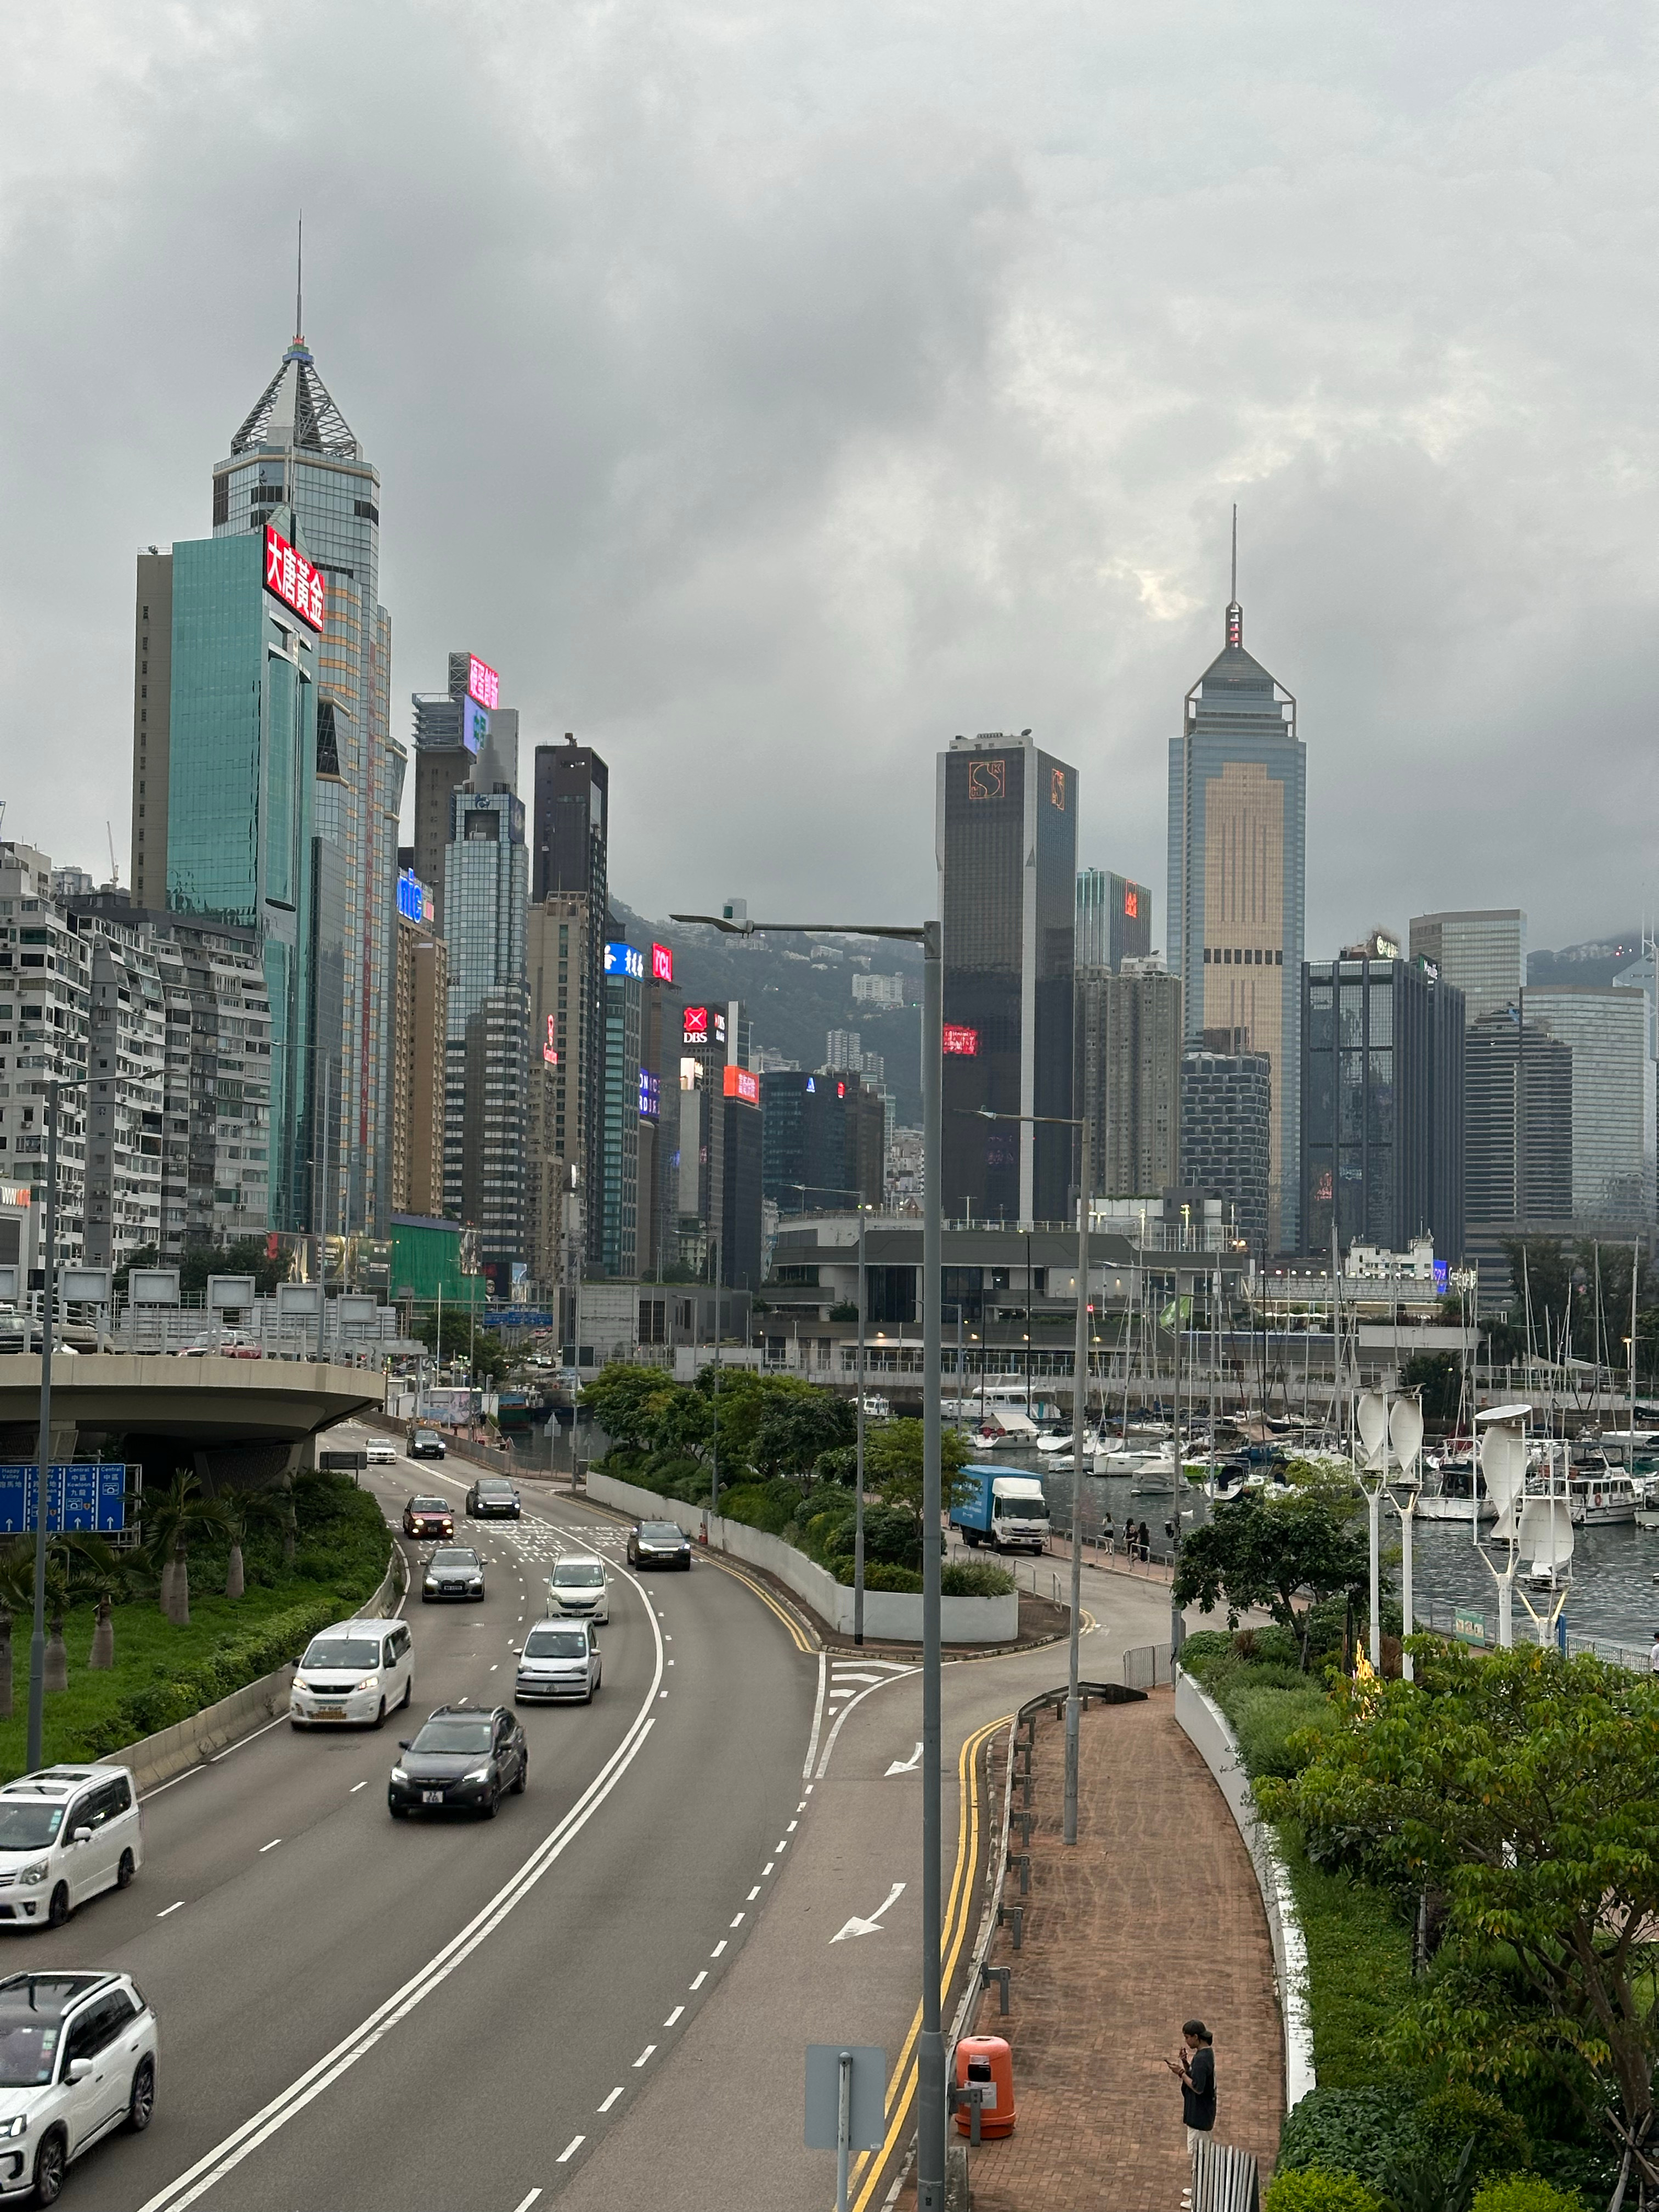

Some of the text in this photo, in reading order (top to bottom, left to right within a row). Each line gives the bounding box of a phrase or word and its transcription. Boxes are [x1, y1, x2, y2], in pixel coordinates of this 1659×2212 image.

[267, 533, 323, 629] 大唐黃金
[656, 949, 670, 979] TCL
[684, 1032, 708, 1042] DBS
